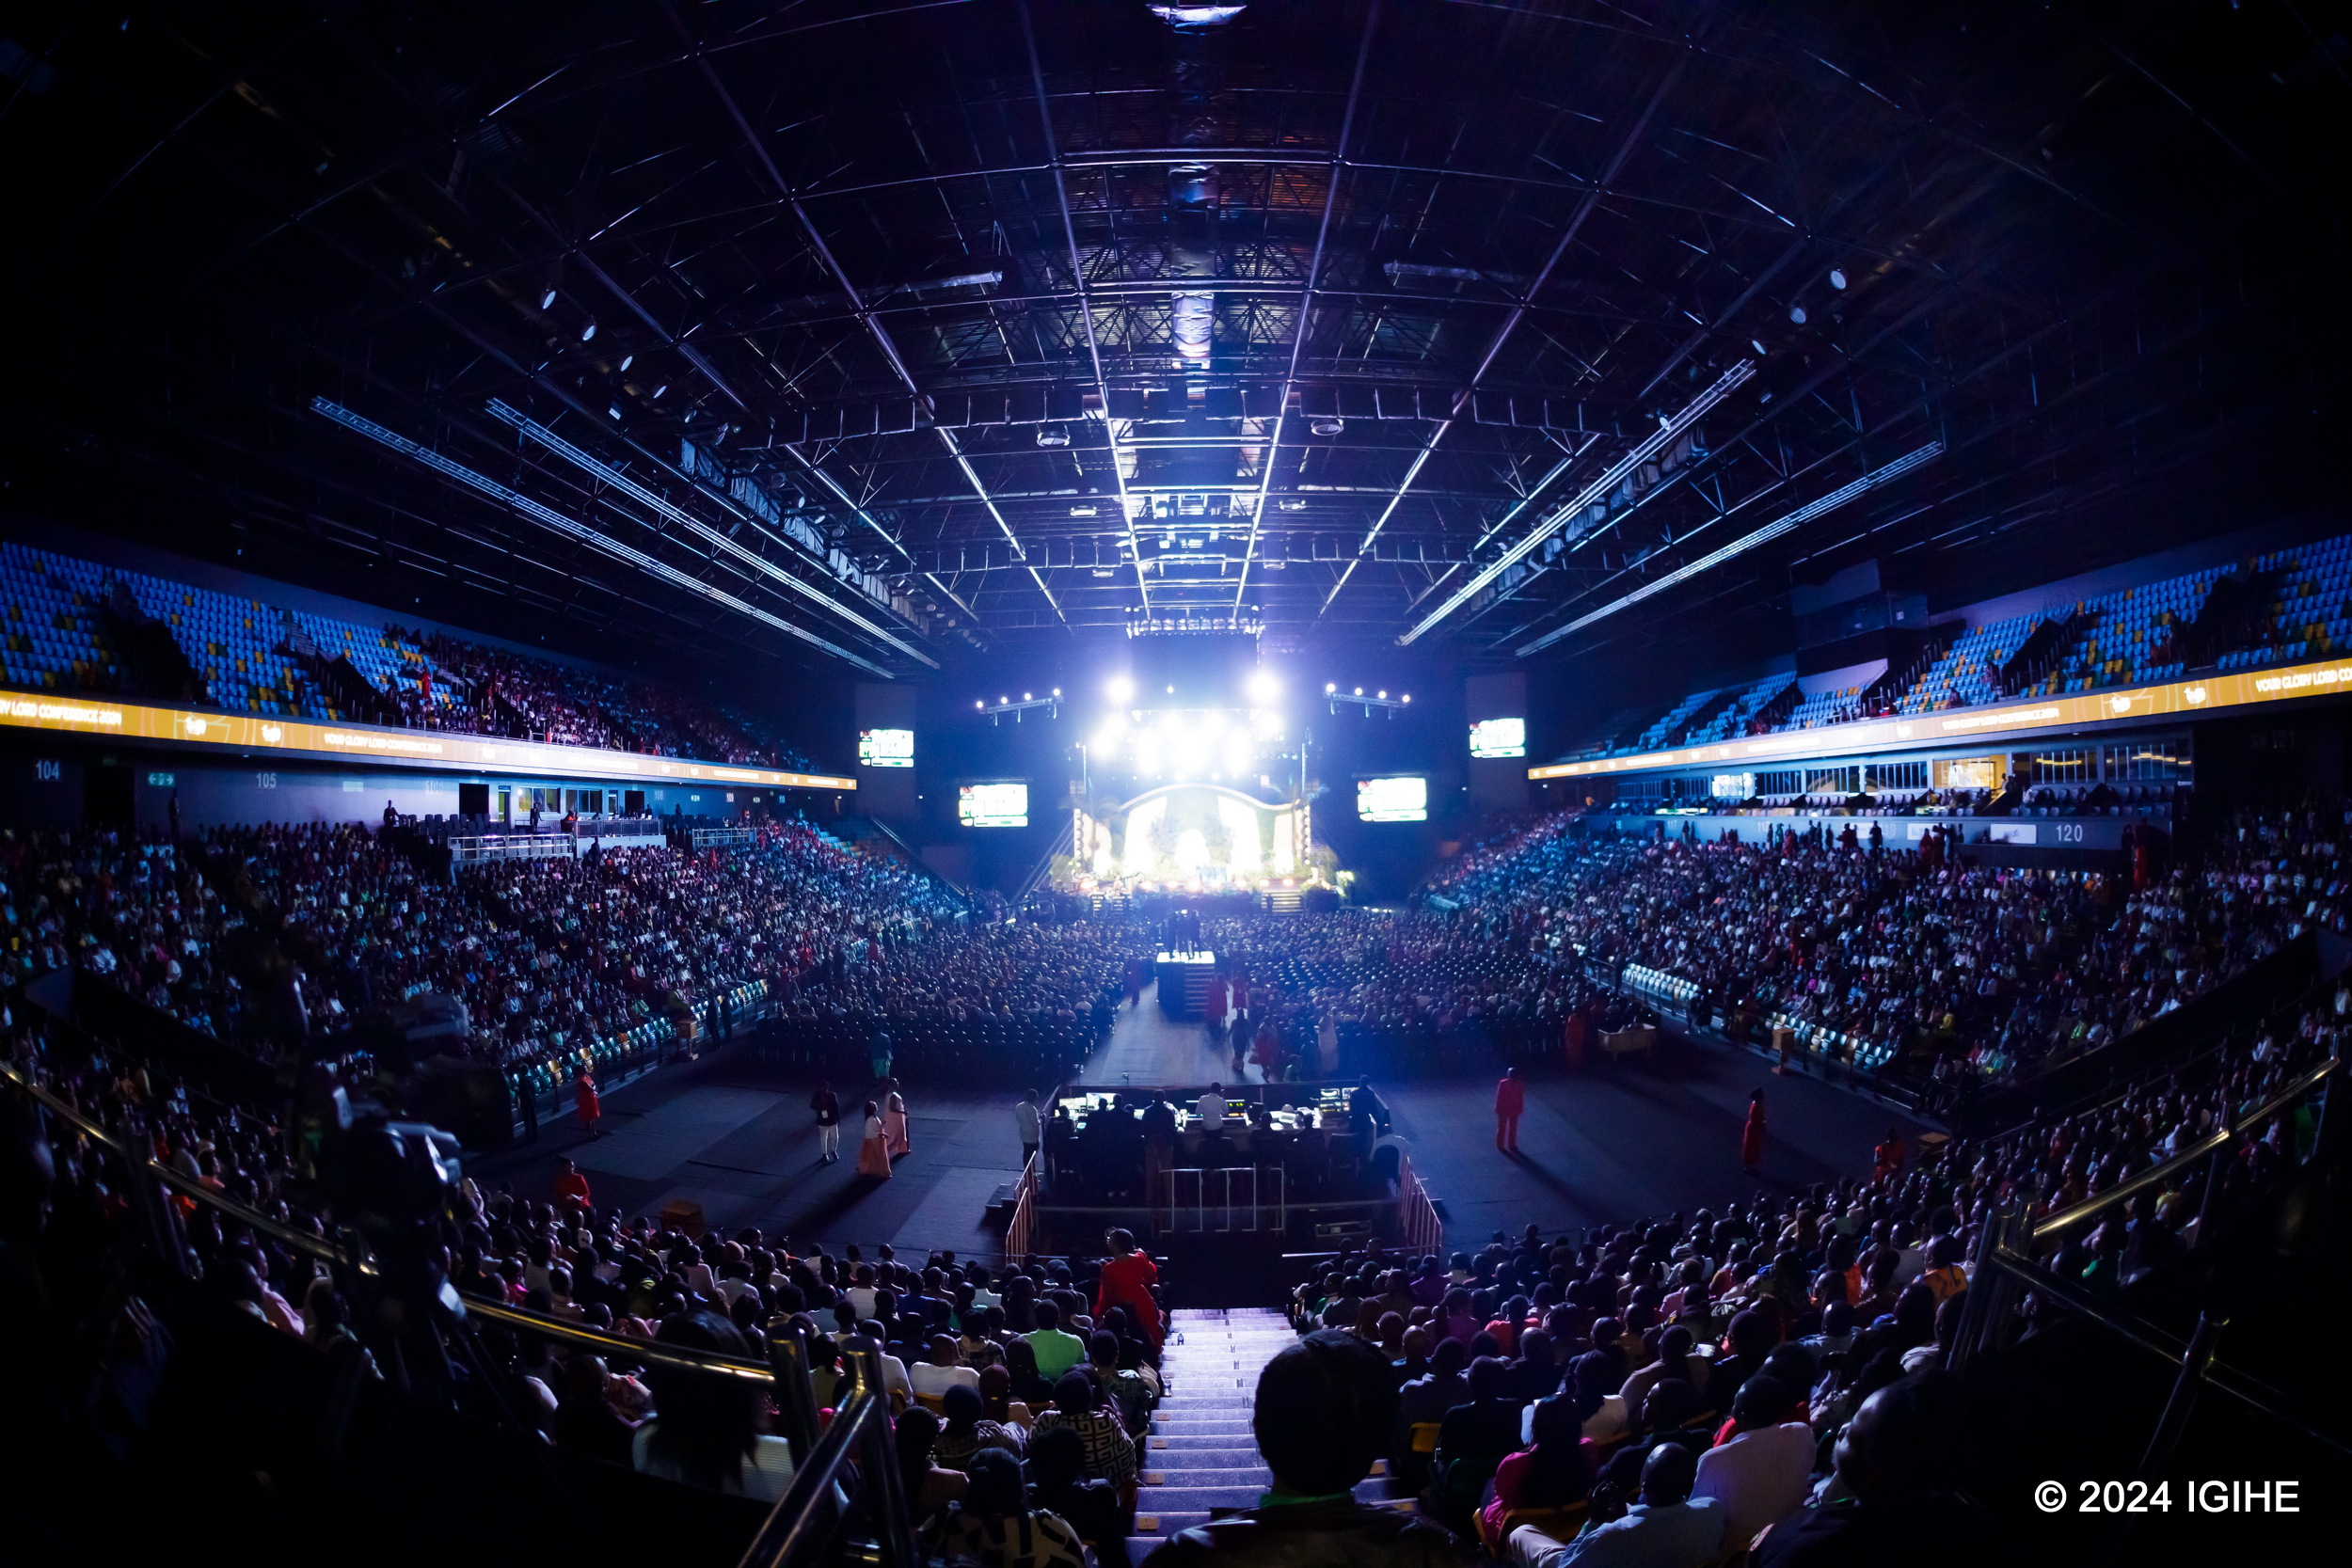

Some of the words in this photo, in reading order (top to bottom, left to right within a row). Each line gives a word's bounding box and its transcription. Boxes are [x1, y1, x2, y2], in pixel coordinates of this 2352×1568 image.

[2256, 677, 2281, 692] YOUR
[2281, 673, 2312, 689] GLORY
[2312, 670, 2338, 685] LORD
[11, 701, 38, 718] LORD
[39, 704, 99, 724] CONFERENCE
[324, 733, 345, 745] YOUR
[345, 735, 369, 748] GLORY
[368, 736, 388, 750] LORD
[35, 759, 60, 781] 104
[256, 771, 278, 789] 105
[2056, 824, 2084, 843] 120
